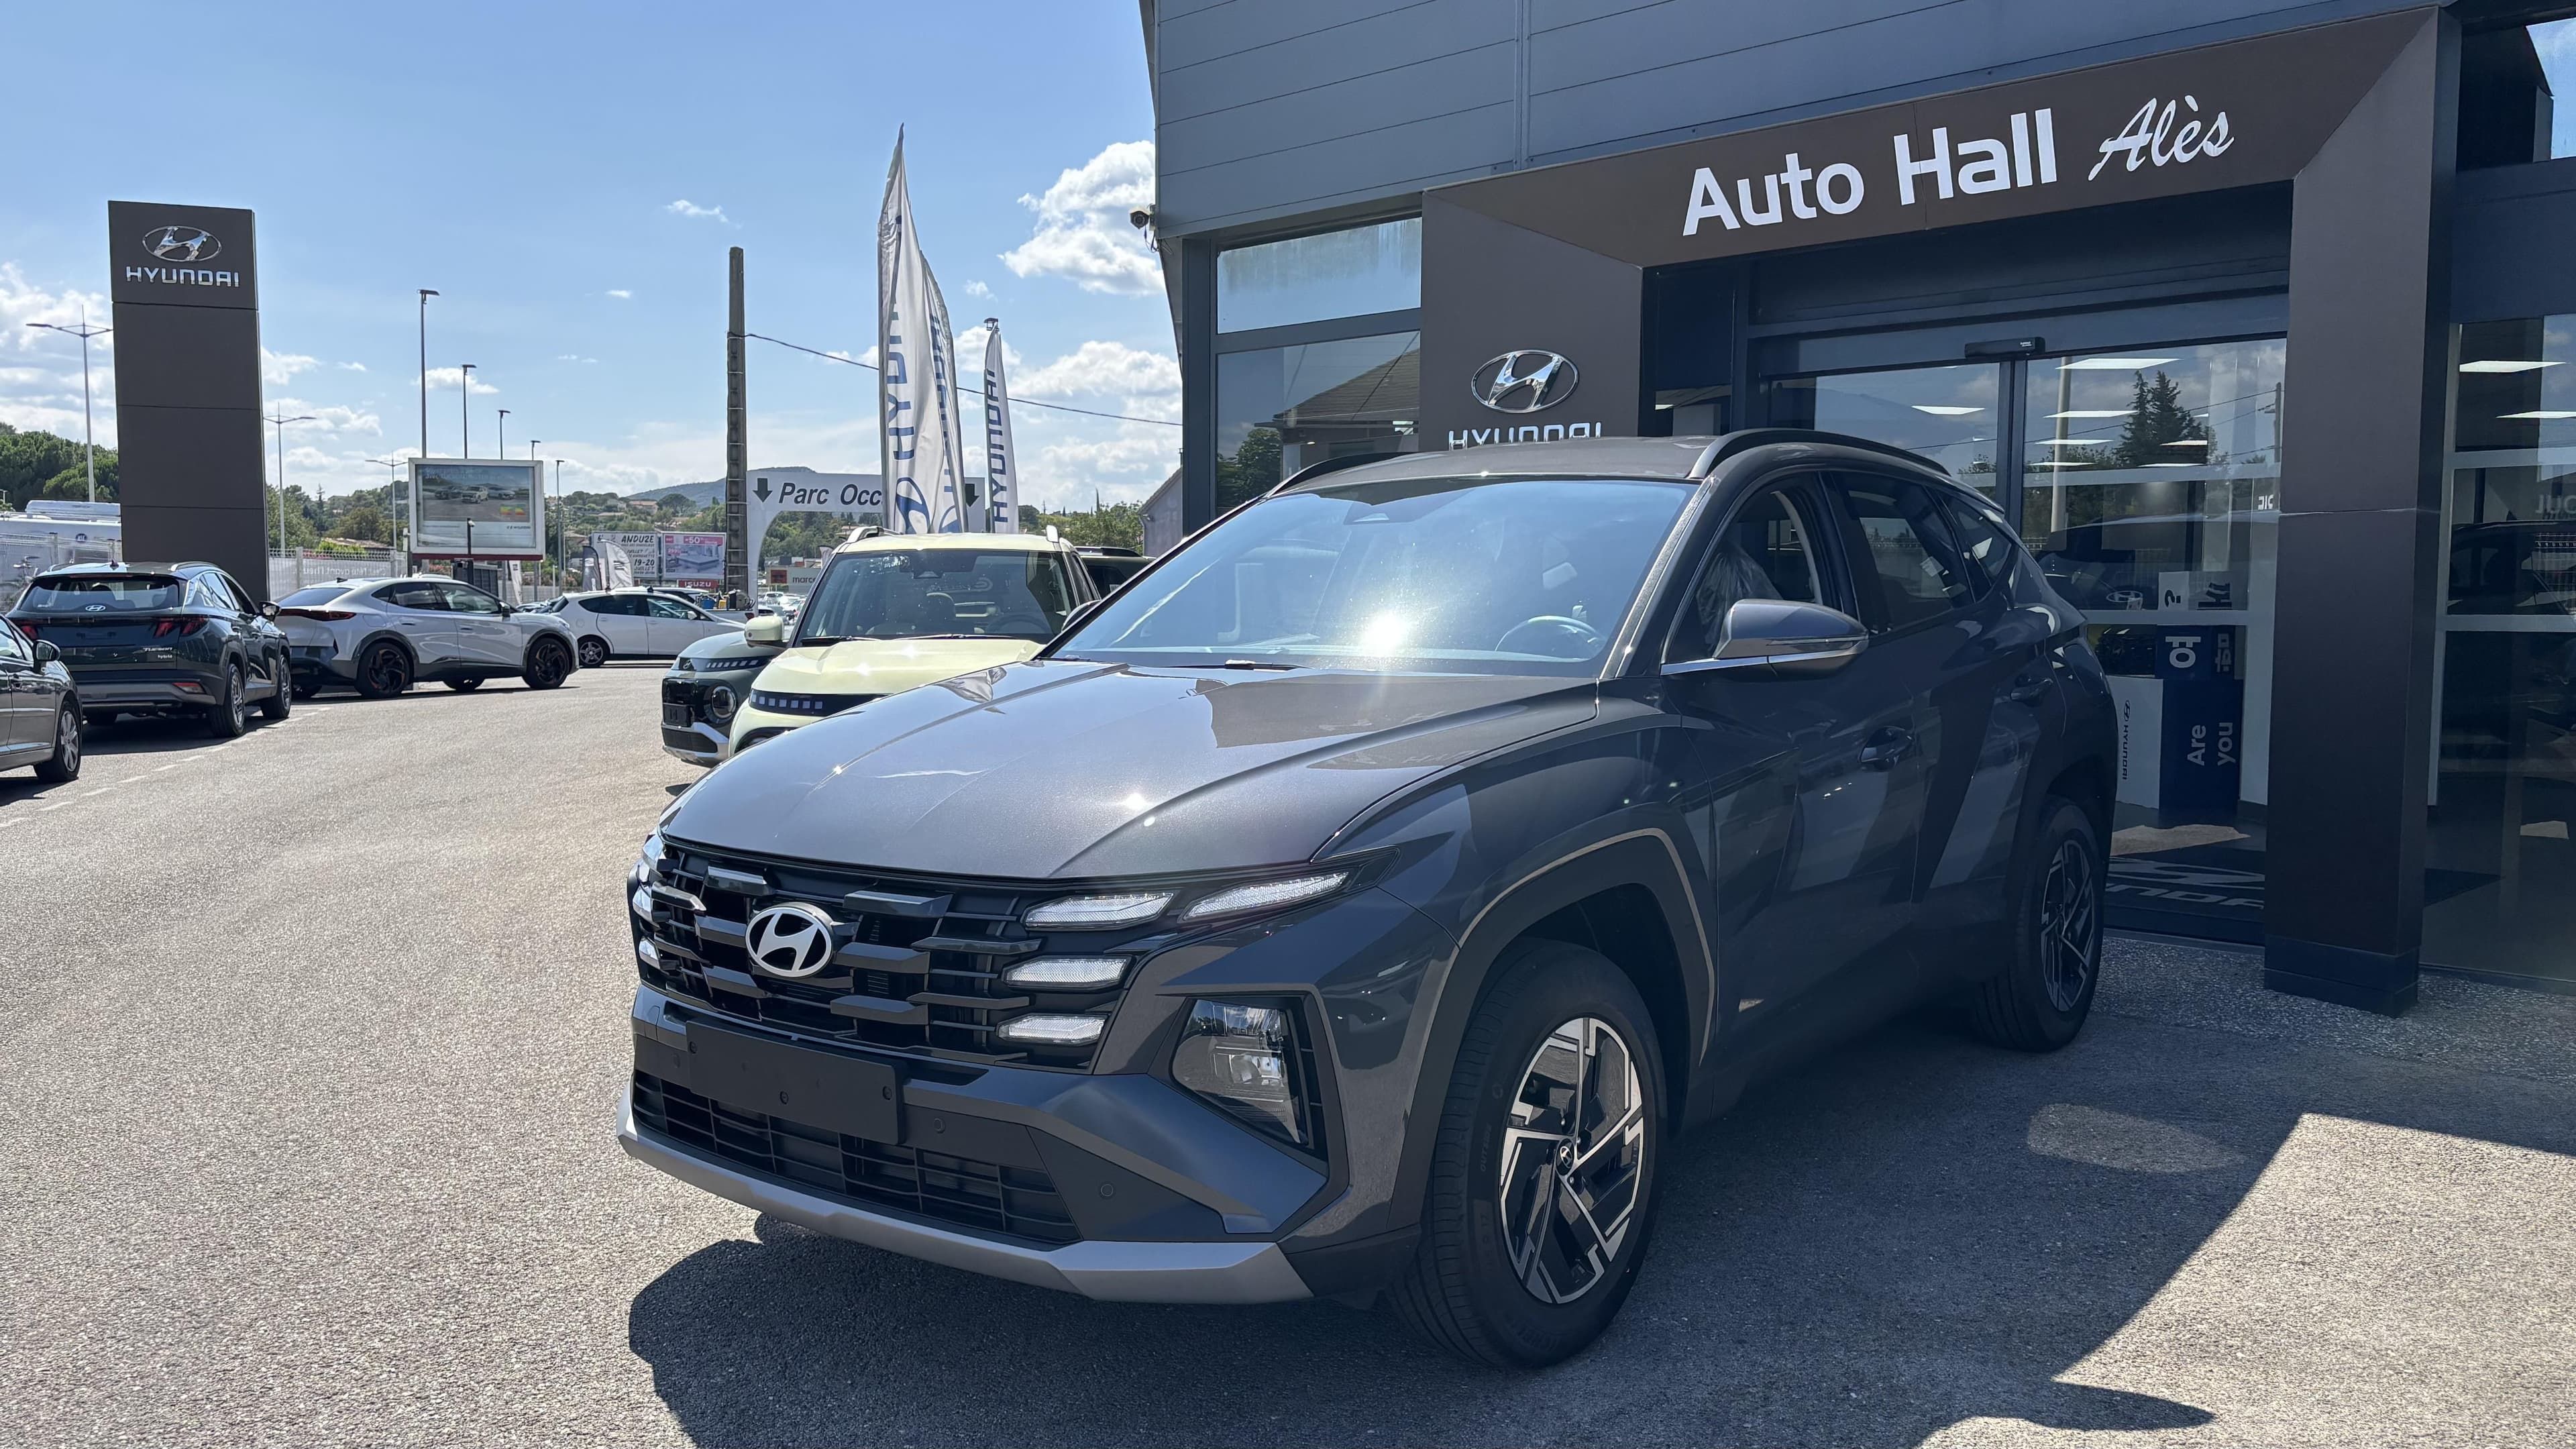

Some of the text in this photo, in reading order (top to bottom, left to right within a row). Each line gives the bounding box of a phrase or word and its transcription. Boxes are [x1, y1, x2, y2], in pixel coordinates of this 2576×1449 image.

[1682, 94, 2235, 236] Auto Hall Alès
[125, 266, 239, 287] HYUNDAI
[1448, 421, 1602, 451] HYUNDAI
[779, 482, 883, 506] Parc Occ
[621, 535, 654, 543] ANDUZE
[2121, 724, 2129, 781] HYUNDAI
[2186, 724, 2207, 766] Are
[2216, 722, 2235, 766] you
